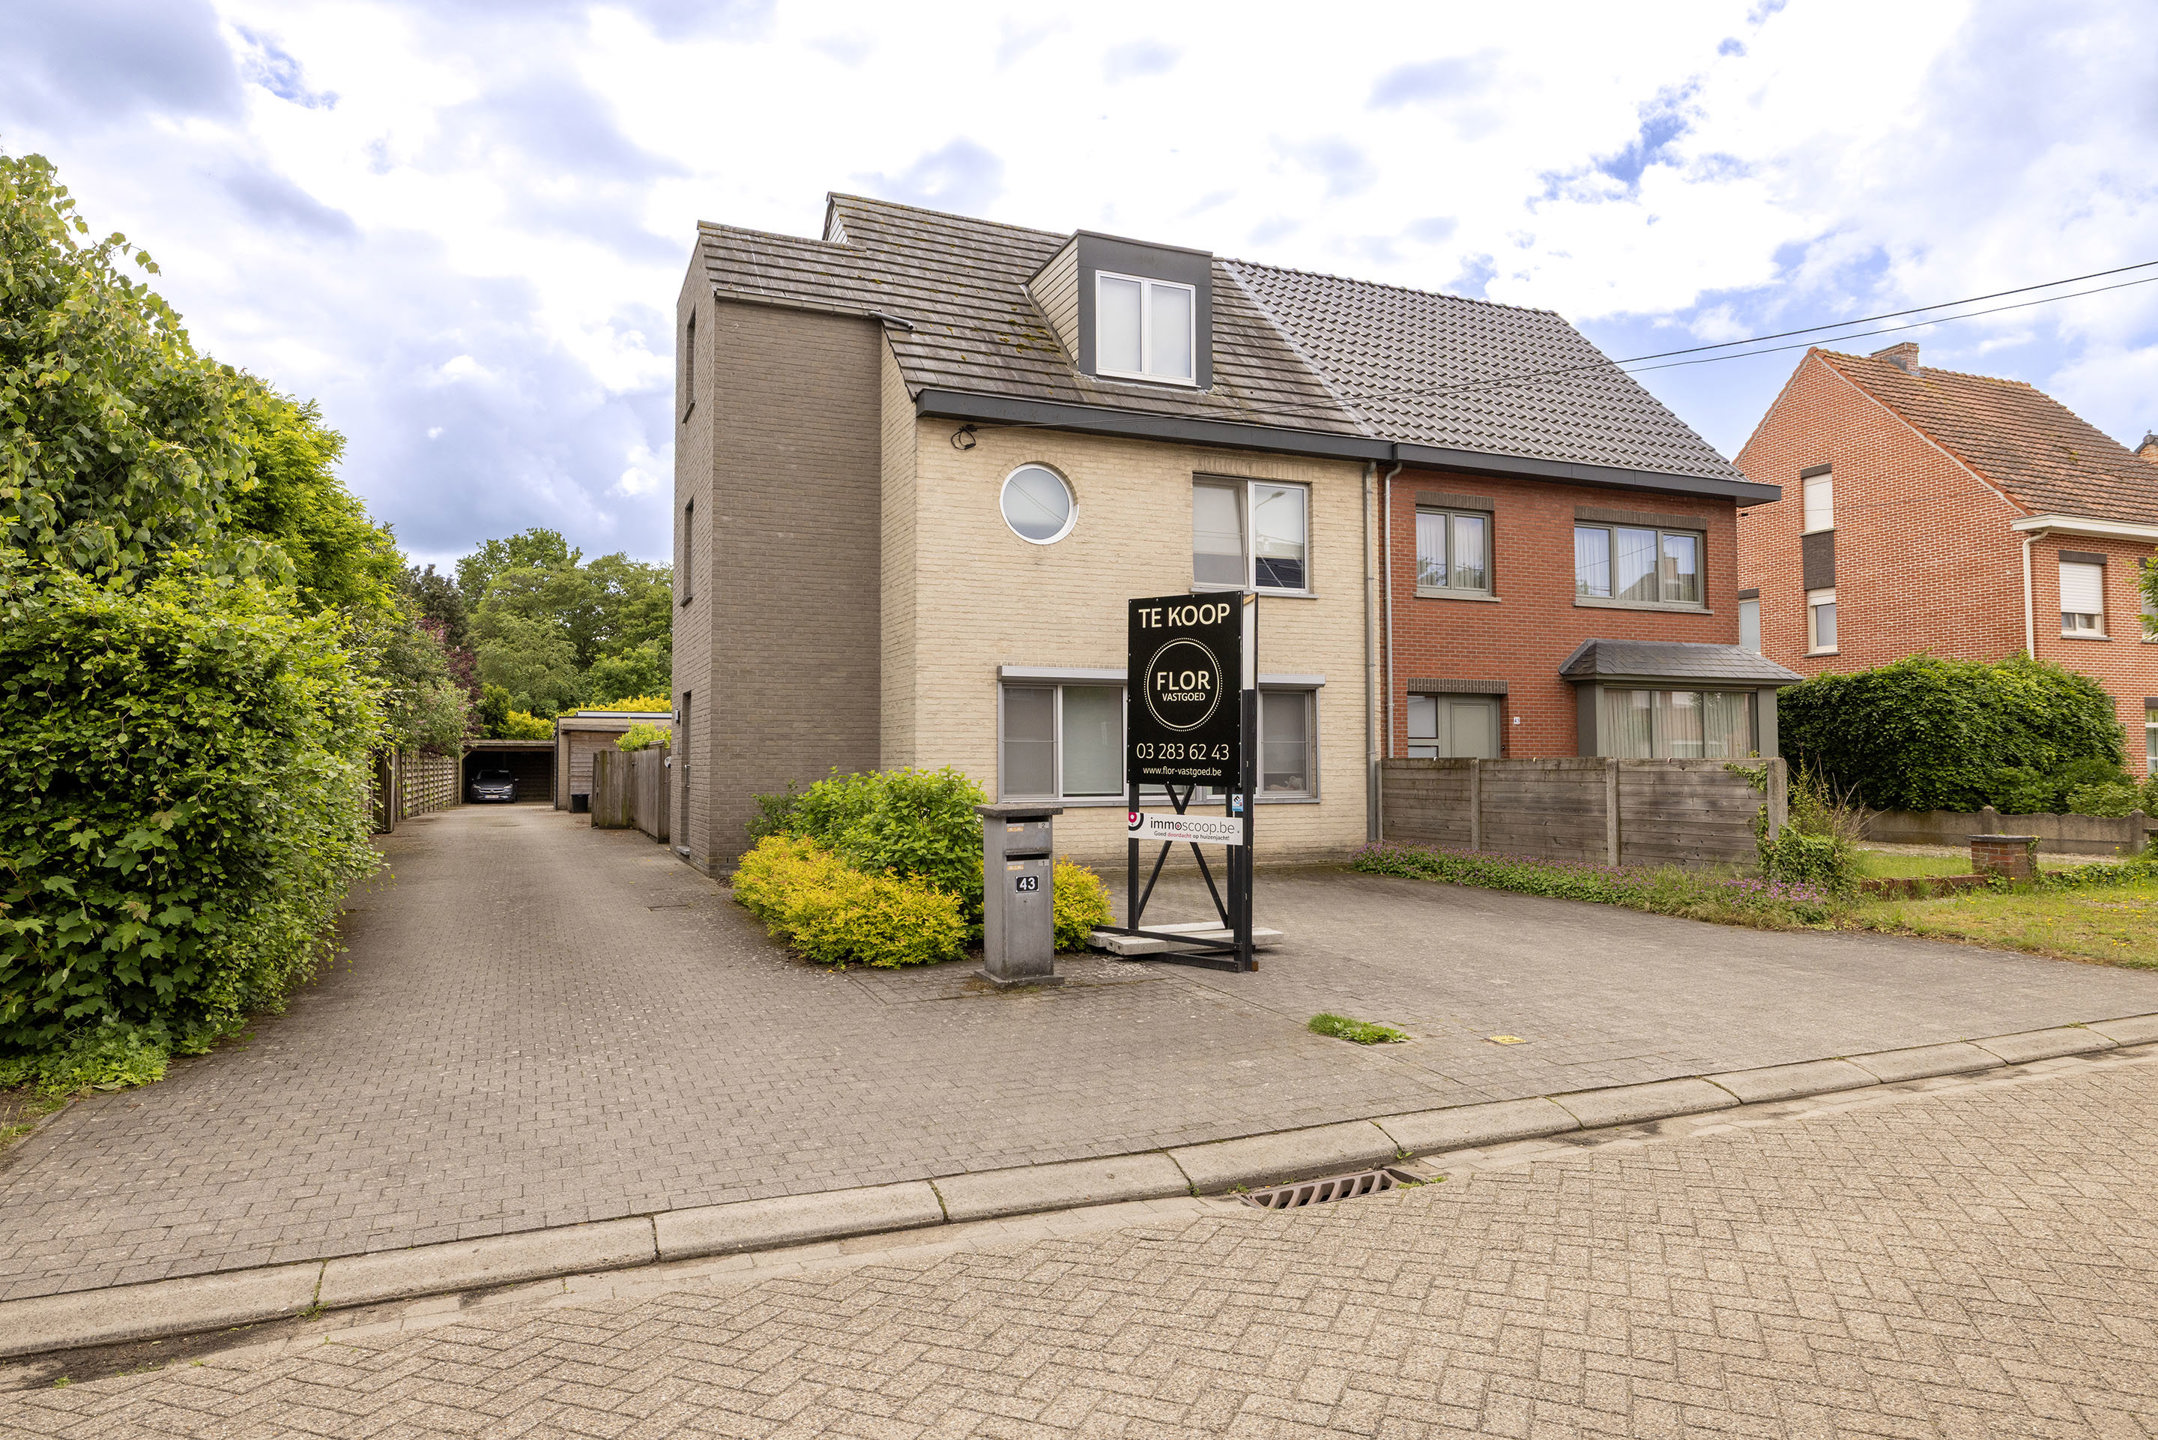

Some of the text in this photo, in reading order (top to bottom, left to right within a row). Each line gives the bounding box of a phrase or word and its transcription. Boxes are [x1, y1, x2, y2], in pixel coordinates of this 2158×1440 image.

[1138, 603, 1230, 628] TE KOOP
[1157, 671, 1211, 691] FLOR
[1162, 692, 1206, 702] VASTGOED
[1136, 743, 1230, 761] 03 283 62 43
[1143, 766, 1222, 778] www.flor-vastgoed.be
[1150, 817, 1235, 835] immoscoop.be
[1019, 877, 1036, 890] 43
